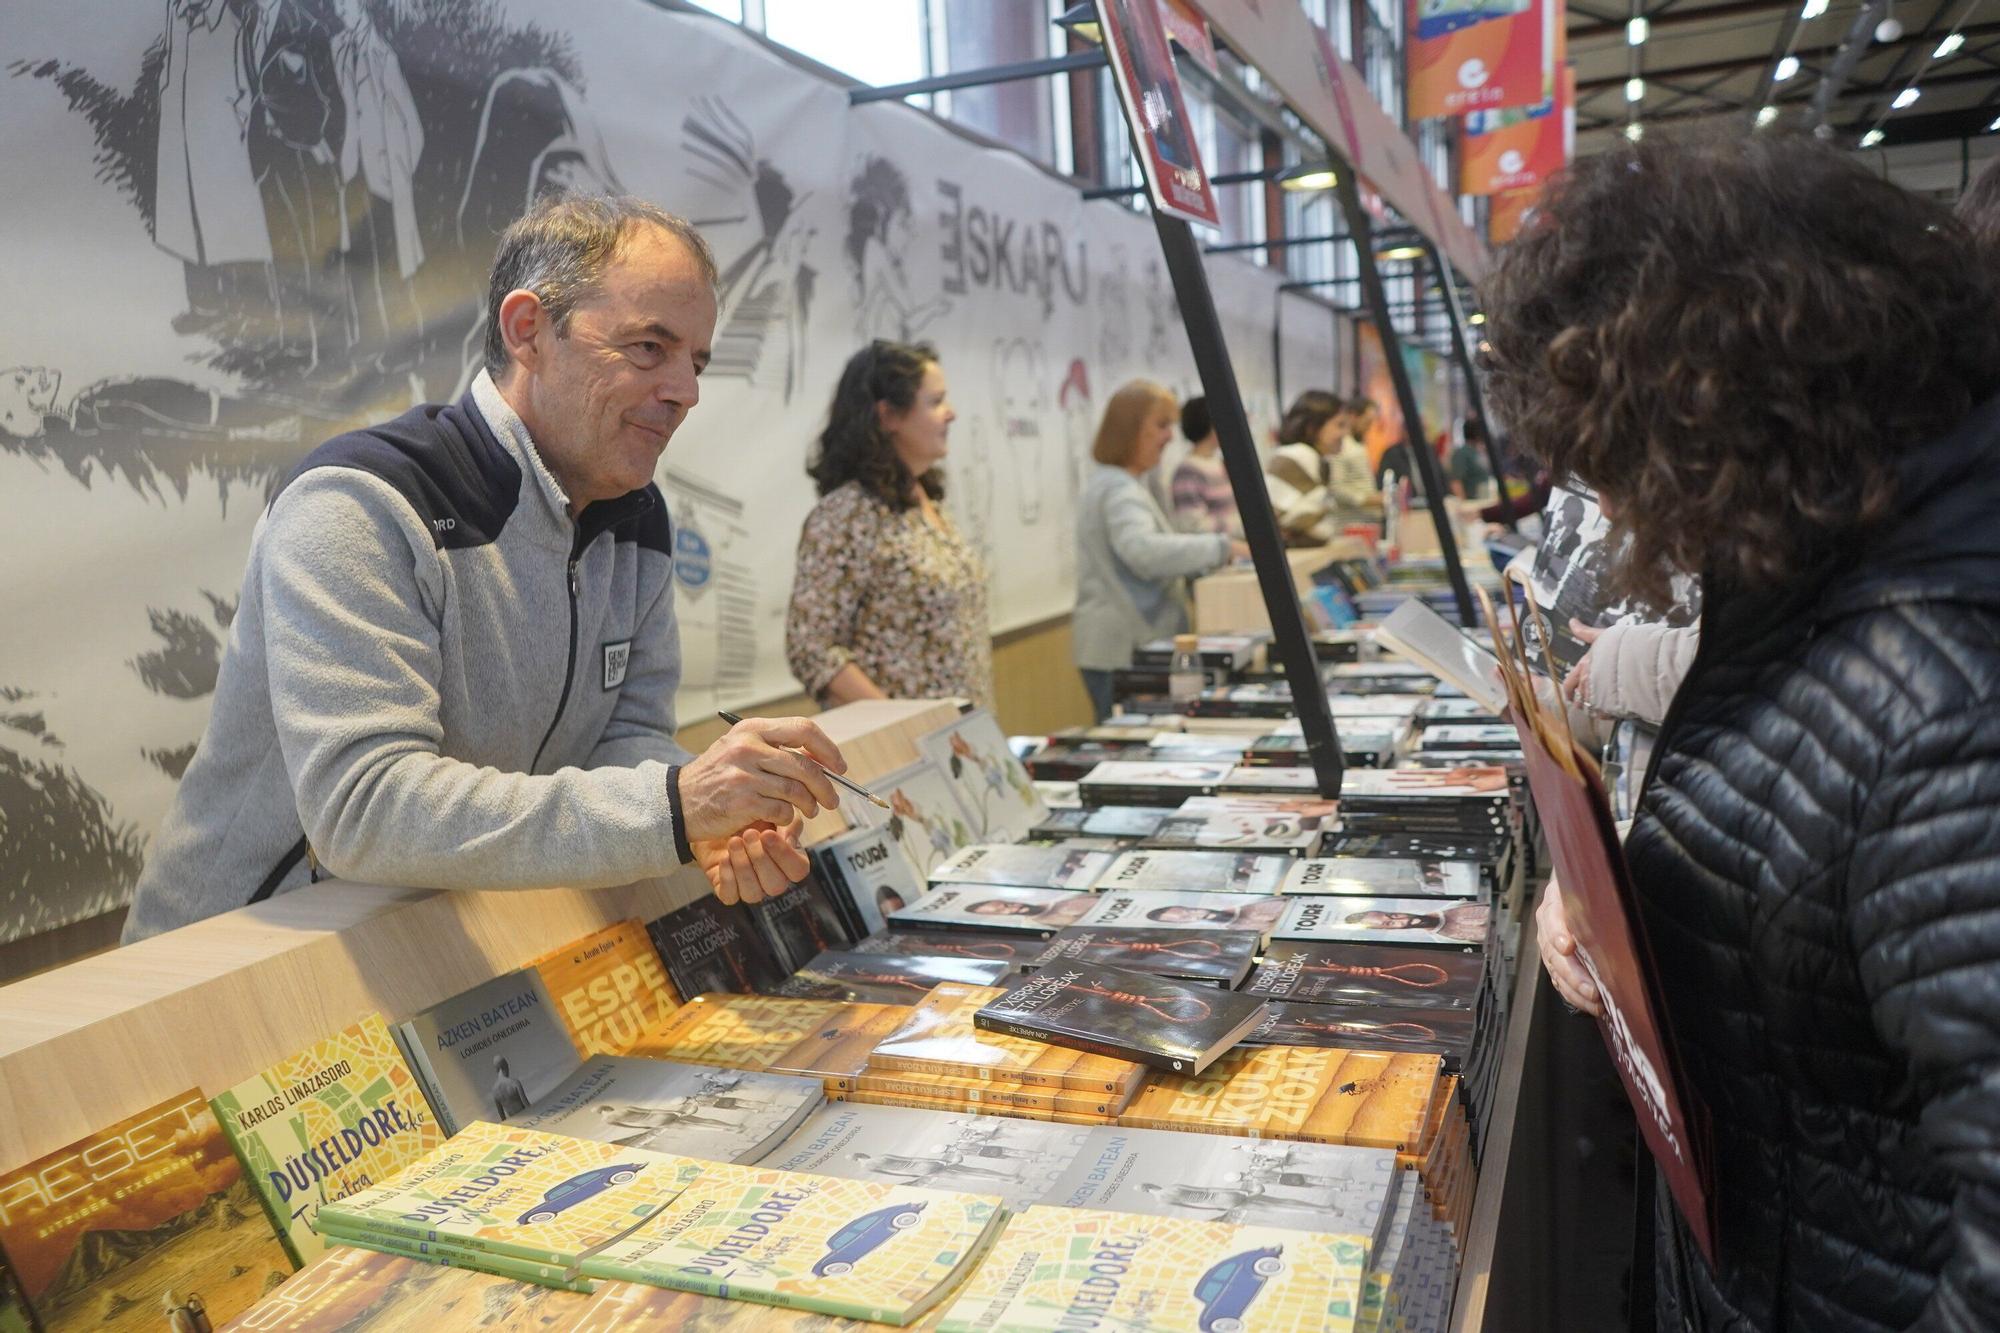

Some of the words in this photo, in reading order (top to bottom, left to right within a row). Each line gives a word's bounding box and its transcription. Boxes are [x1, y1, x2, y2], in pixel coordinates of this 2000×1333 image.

[433, 518, 455, 531] RD
[561, 952, 668, 1031] ESPE
[993, 975, 1055, 1010] TXERRIAK
[1033, 970, 1084, 1000] LOREAK
[437, 1017, 482, 1051] AZKEN
[481, 990, 539, 1028] BATEAN
[579, 988, 681, 1057] KULA
[237, 1095, 285, 1131] KARLOS
[282, 1059, 352, 1106] LINAZASORO
[1258, 1048, 1332, 1126] ZIOAK
[776, 1151, 817, 1171] ZKEN
[808, 1111, 859, 1150] BATEAN
[395, 1152, 464, 1191] LINAZASORO
[1065, 1181, 1100, 1207] ZKEN
[1088, 1136, 1128, 1181] BATEAN
[654, 1199, 716, 1242] LINAZASORO
